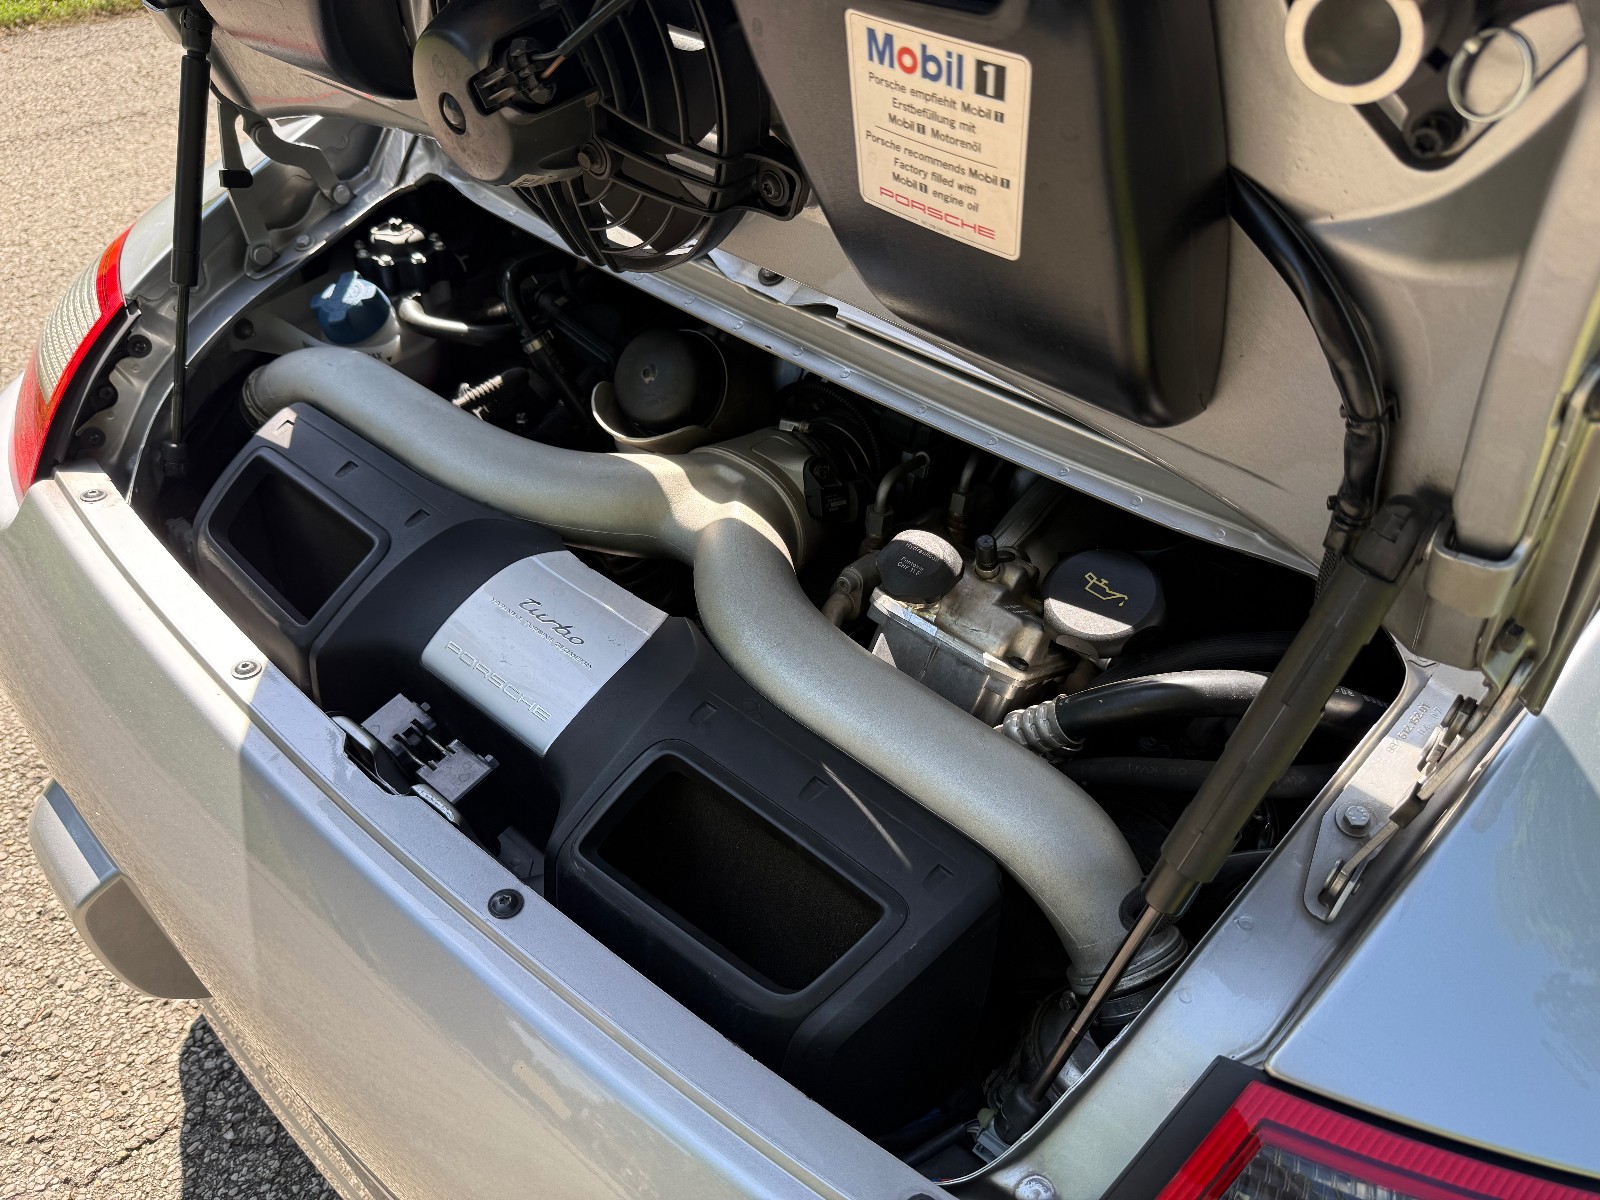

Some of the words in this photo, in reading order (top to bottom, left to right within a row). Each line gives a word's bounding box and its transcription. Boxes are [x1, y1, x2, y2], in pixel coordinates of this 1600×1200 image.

[866, 27, 964, 91] Mobil
[868, 71, 907, 93] Porsche
[909, 87, 958, 110] empfiehlt
[961, 101, 992, 120] Mobil
[994, 111, 1004, 123] 1
[892, 97, 957, 130] Erstbefüllung
[959, 120, 976, 134] mit
[888, 112, 915, 131] Mobil
[916, 123, 926, 135] 1
[930, 127, 982, 153] Motorenöl
[865, 130, 901, 152] Porsche
[904, 146, 966, 175] recommends
[968, 167, 998, 185] Mobil
[1000, 177, 1010, 189] 1
[893, 157, 928, 179] Factory
[931, 172, 955, 188] filled
[957, 181, 977, 196] with
[879, 186, 996, 240] PORSCHE
[892, 171, 917, 191] Mobil
[919, 182, 928, 194] 1
[932, 189, 964, 207] engine
[966, 201, 979, 213] oil
[524, 619, 554, 643] TURBINE
[554, 641, 593, 671] GEOMETRY
[444, 640, 552, 723] PORSCHE
